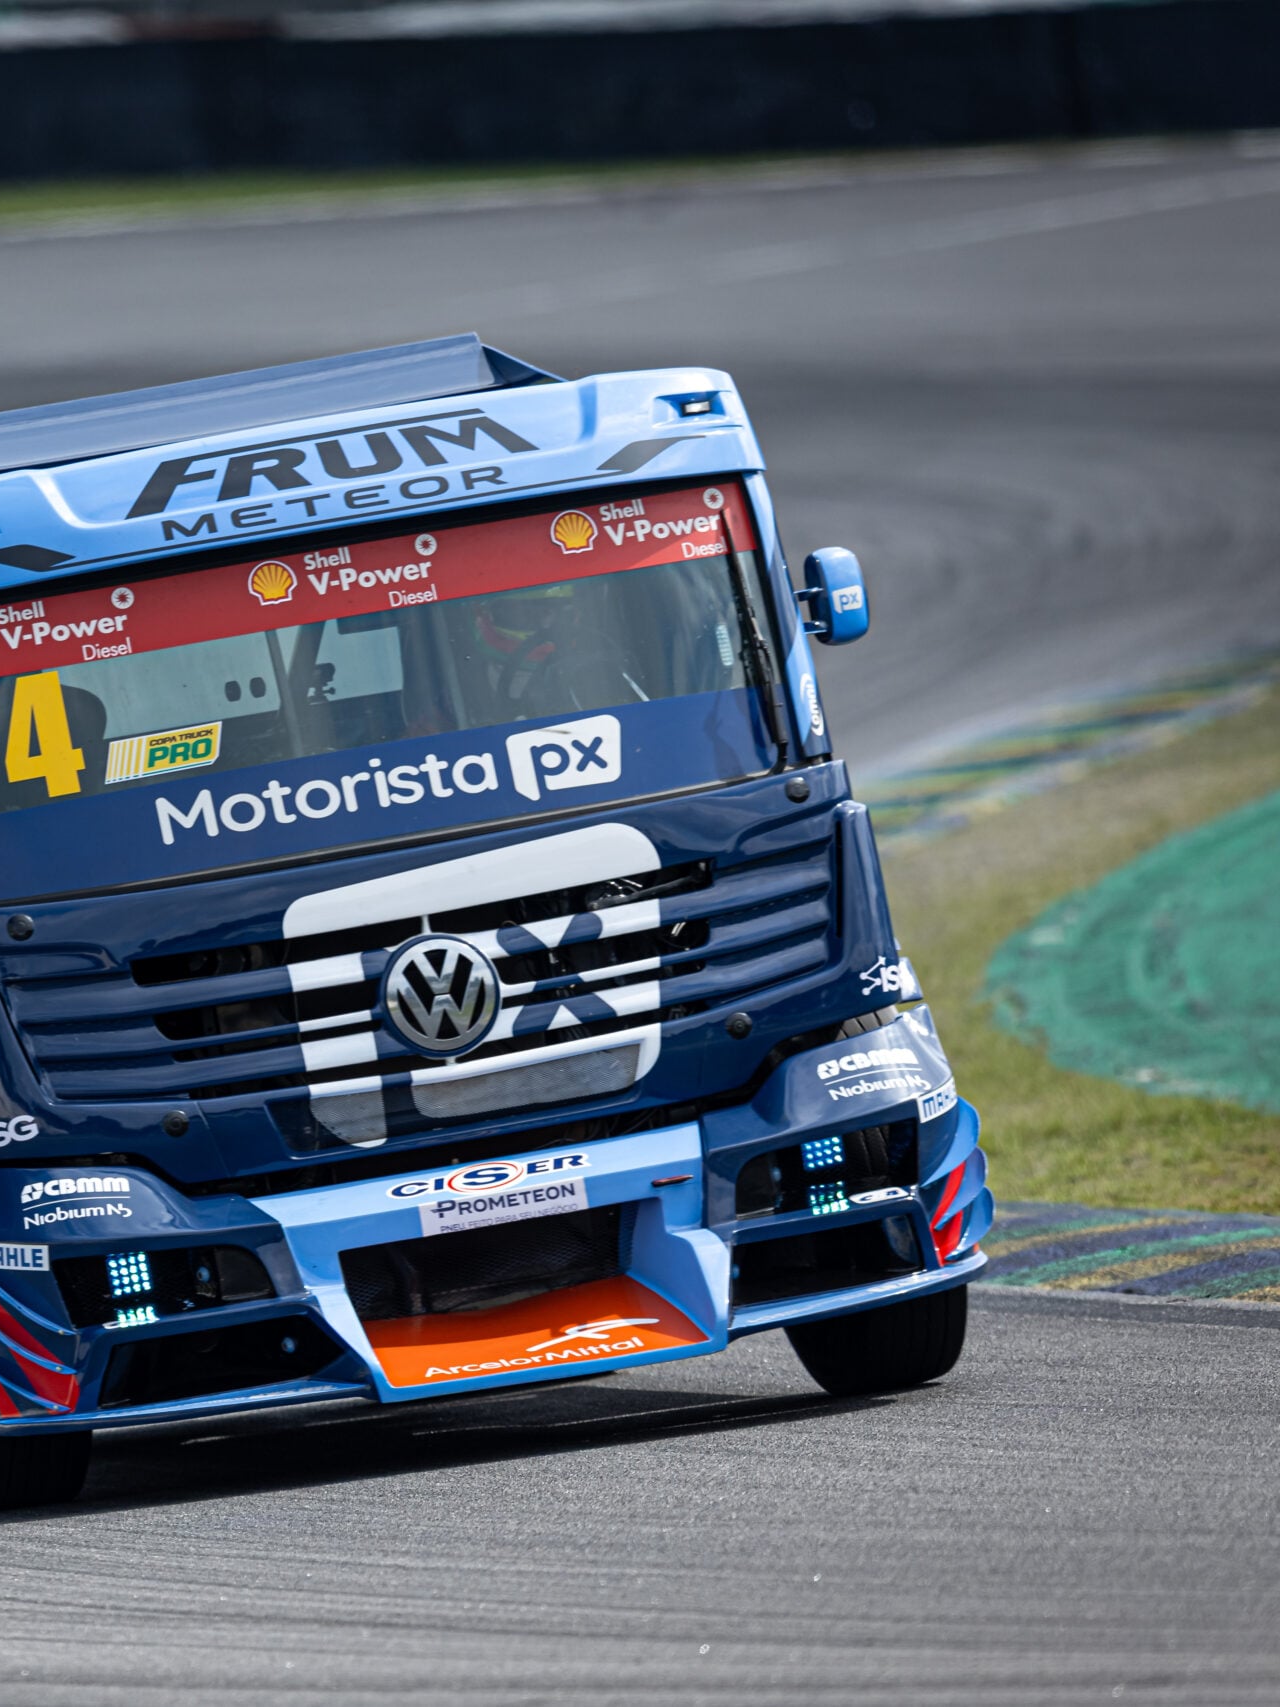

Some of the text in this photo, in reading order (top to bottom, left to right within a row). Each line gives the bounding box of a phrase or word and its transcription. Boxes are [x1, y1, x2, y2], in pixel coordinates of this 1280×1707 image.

[125, 408, 539, 520] FRUM
[161, 465, 508, 541] METEOR
[600, 499, 644, 523] Shell
[605, 510, 720, 547] V-Power
[682, 535, 727, 558] Diesel
[304, 547, 351, 571] Shell
[307, 559, 432, 596] V-Power
[389, 583, 438, 608] Diesel
[839, 593, 859, 611] px
[0, 613, 128, 650] V-Power
[82, 638, 132, 661] Diesel
[5, 670, 86, 798] 4
[149, 729, 213, 746] COPA TRUCK
[147, 737, 213, 768] PRO
[155, 735, 608, 845] Motorista px
[391, 1154, 588, 1197] CISER
[430, 1183, 576, 1219] PROMETEON
[440, 1223, 467, 1234] PNEU
[425, 1336, 645, 1378] ArcelorMittal
